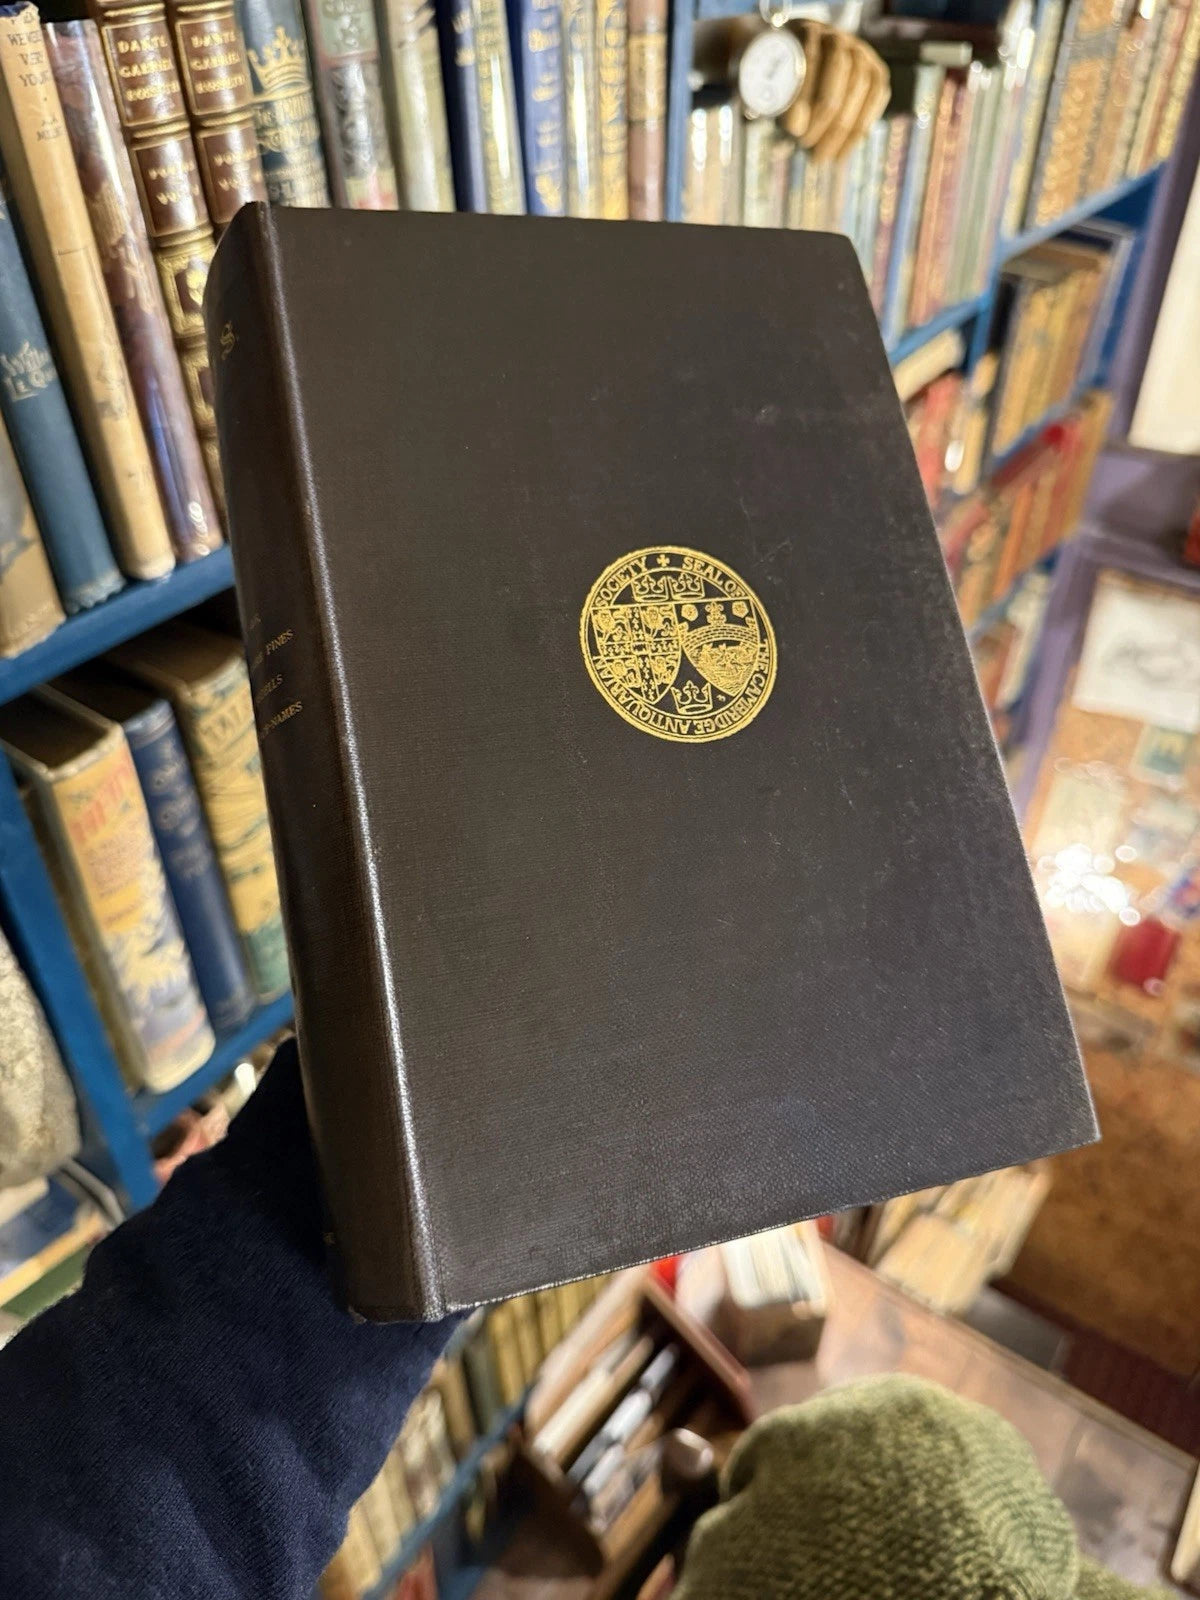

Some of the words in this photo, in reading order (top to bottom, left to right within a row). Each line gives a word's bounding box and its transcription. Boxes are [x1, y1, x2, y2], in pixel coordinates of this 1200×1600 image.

[594, 555, 648, 608] SOCIETY
[681, 555, 724, 586] SEAL
[723, 581, 748, 599] OF
[265, 628, 294, 656] FINES
[756, 637, 770, 676] THE
[592, 655, 693, 735] ANTIQUARIAN
[693, 674, 767, 735] CAMBRIDGE
